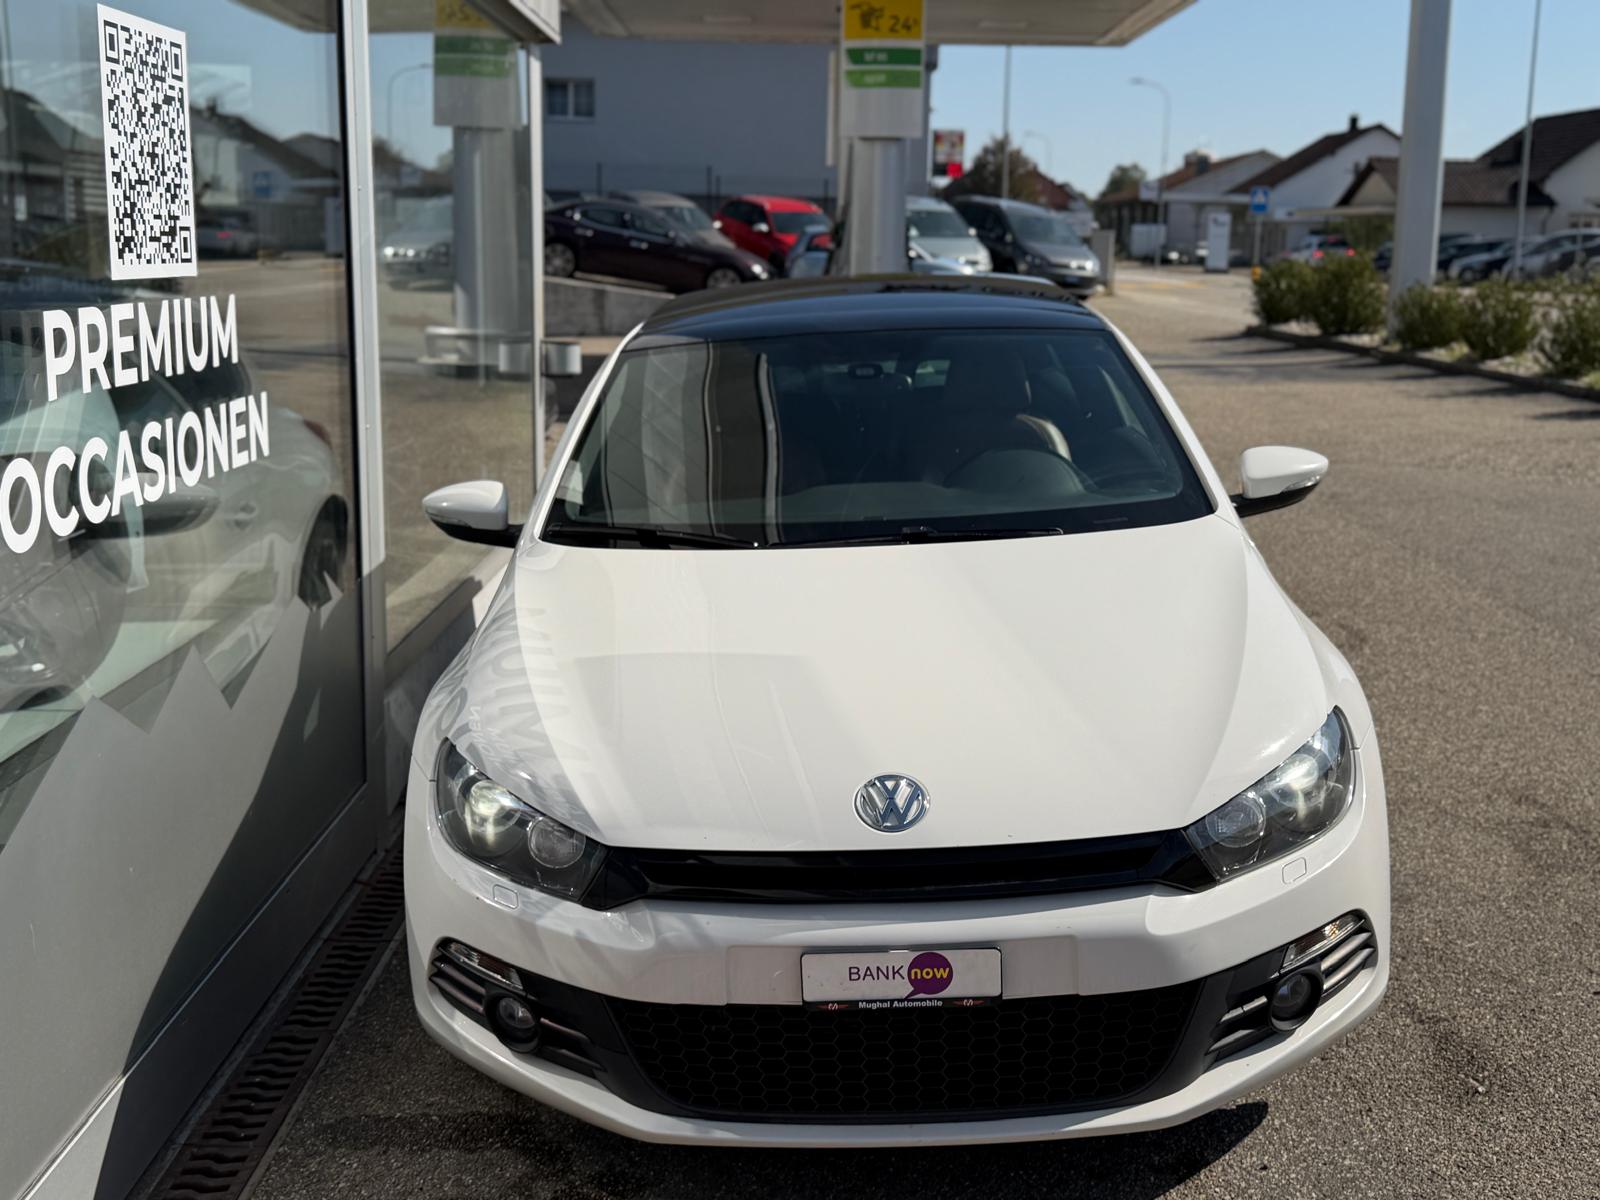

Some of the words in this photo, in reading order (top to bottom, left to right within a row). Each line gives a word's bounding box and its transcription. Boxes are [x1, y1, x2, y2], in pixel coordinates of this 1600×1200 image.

[43, 294, 239, 401] PREMIUM
[0, 391, 270, 554] OCCASIONEN
[848, 965, 905, 982] BANK
[910, 965, 950, 980] now
[858, 1001, 890, 1010] Mughal
[892, 999, 943, 1008] Automobile
